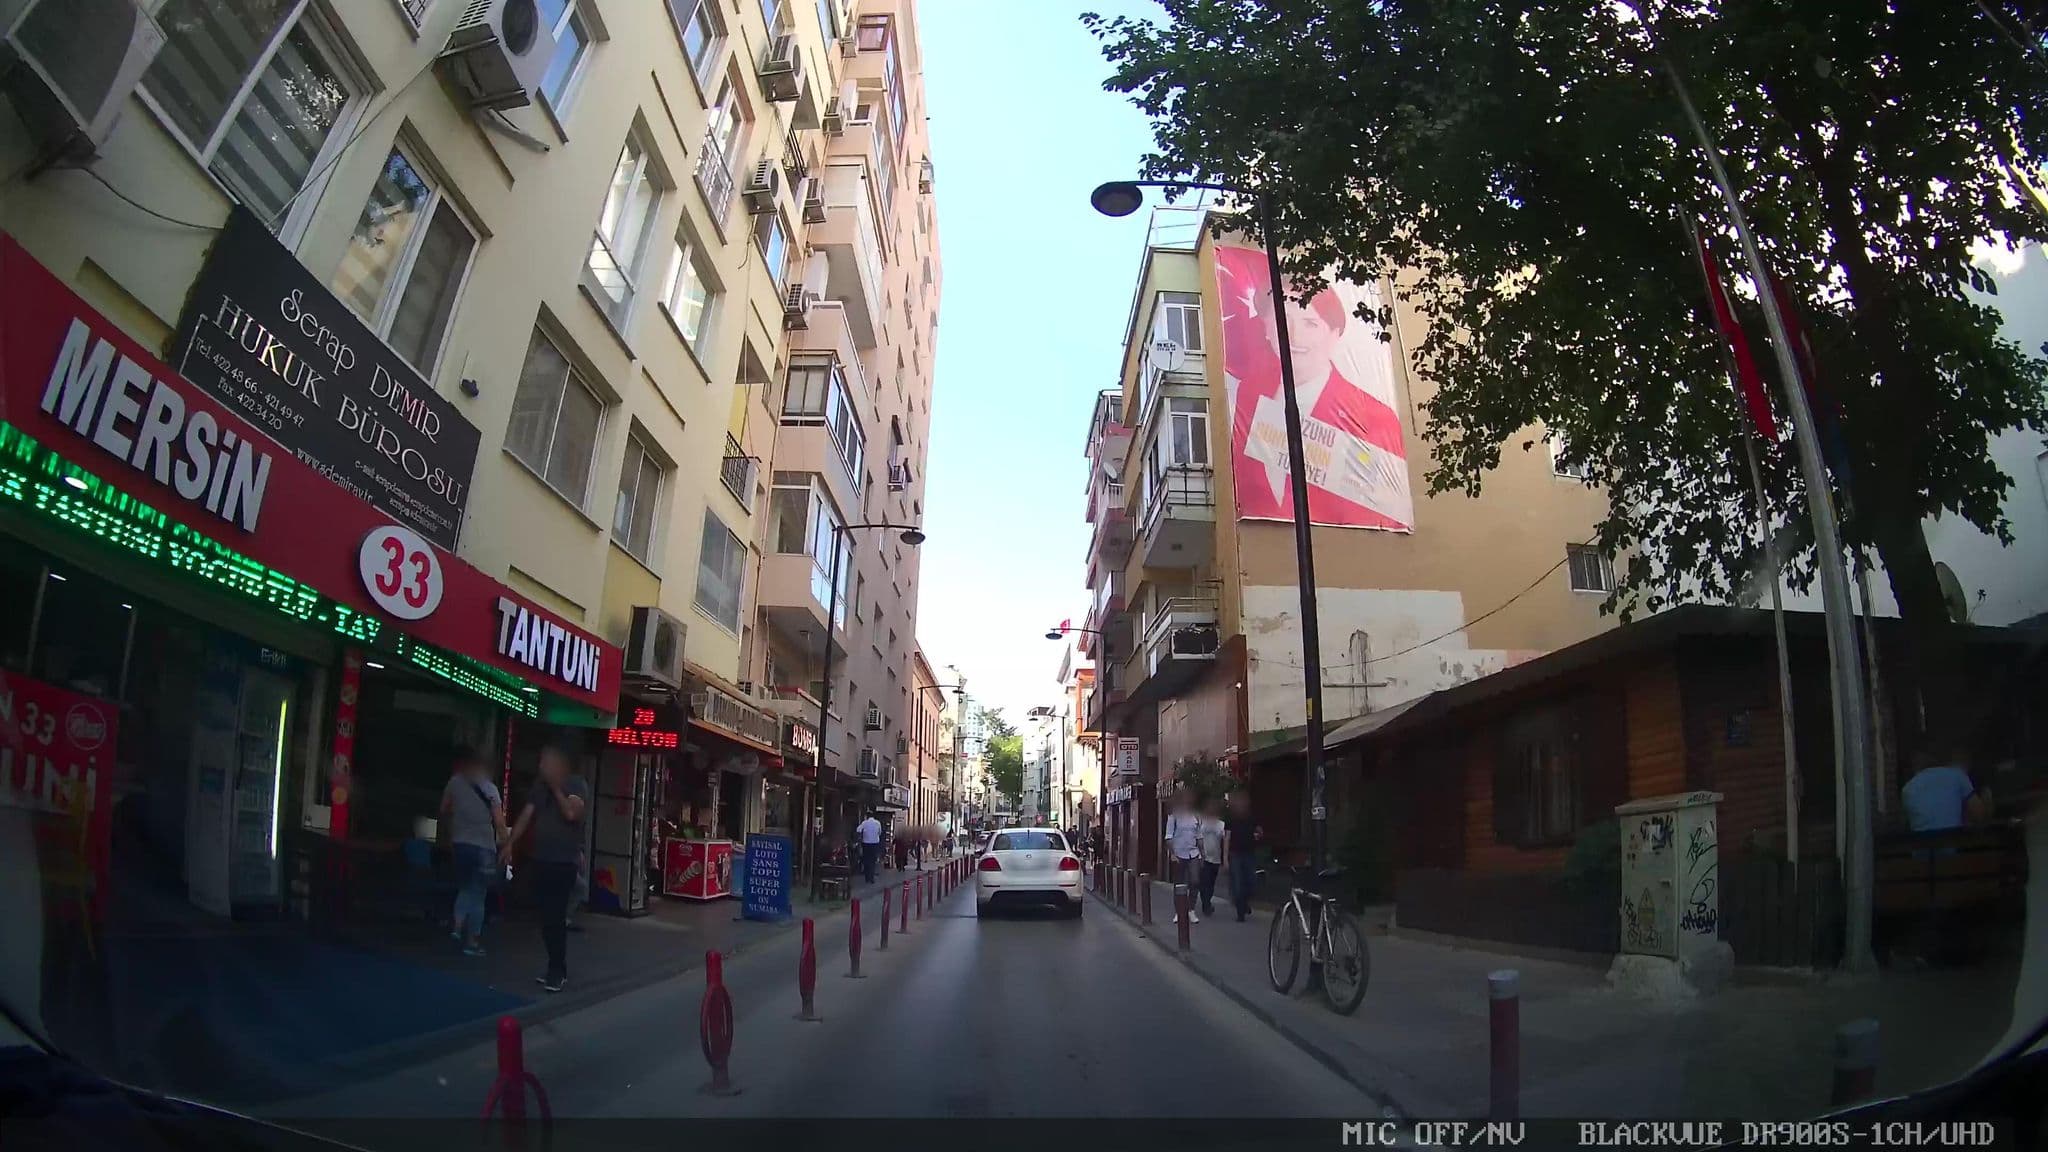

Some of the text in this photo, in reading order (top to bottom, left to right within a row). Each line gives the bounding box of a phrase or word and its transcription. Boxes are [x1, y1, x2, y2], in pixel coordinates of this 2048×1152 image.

[280, 288, 441, 444] Serap DEMİR
[244, 377, 258, 394] 66
[213, 295, 326, 408] HUKUK
[336, 394, 463, 505] BÜROSU
[375, 536, 431, 608] 33
[755, 849, 778, 859] LOTO
[752, 867, 780, 877] TOPU
[751, 886, 778, 897] LOTO
